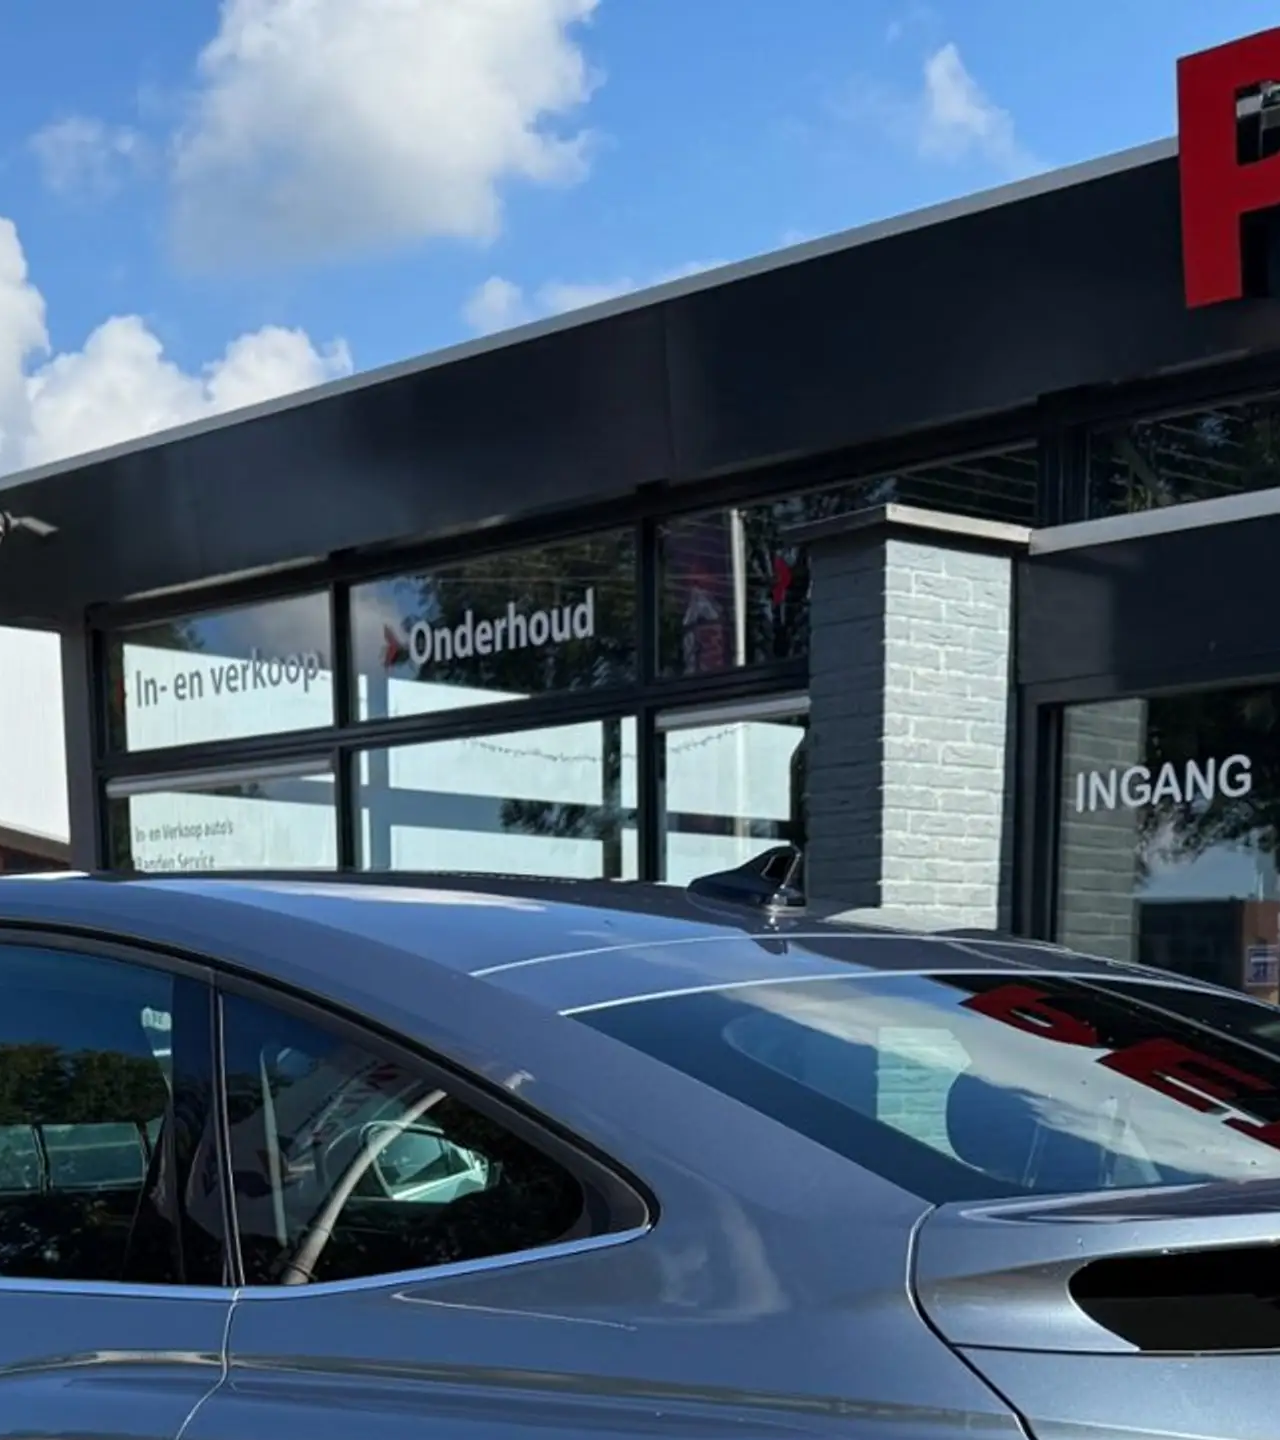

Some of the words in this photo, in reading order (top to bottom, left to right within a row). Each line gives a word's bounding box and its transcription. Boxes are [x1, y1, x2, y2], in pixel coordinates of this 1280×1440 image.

[409, 587, 595, 665] Onderhoud
[135, 669, 167, 708] In-
[173, 670, 204, 701] en
[210, 647, 320, 694] verkoop
[1076, 754, 1252, 813] INGANG
